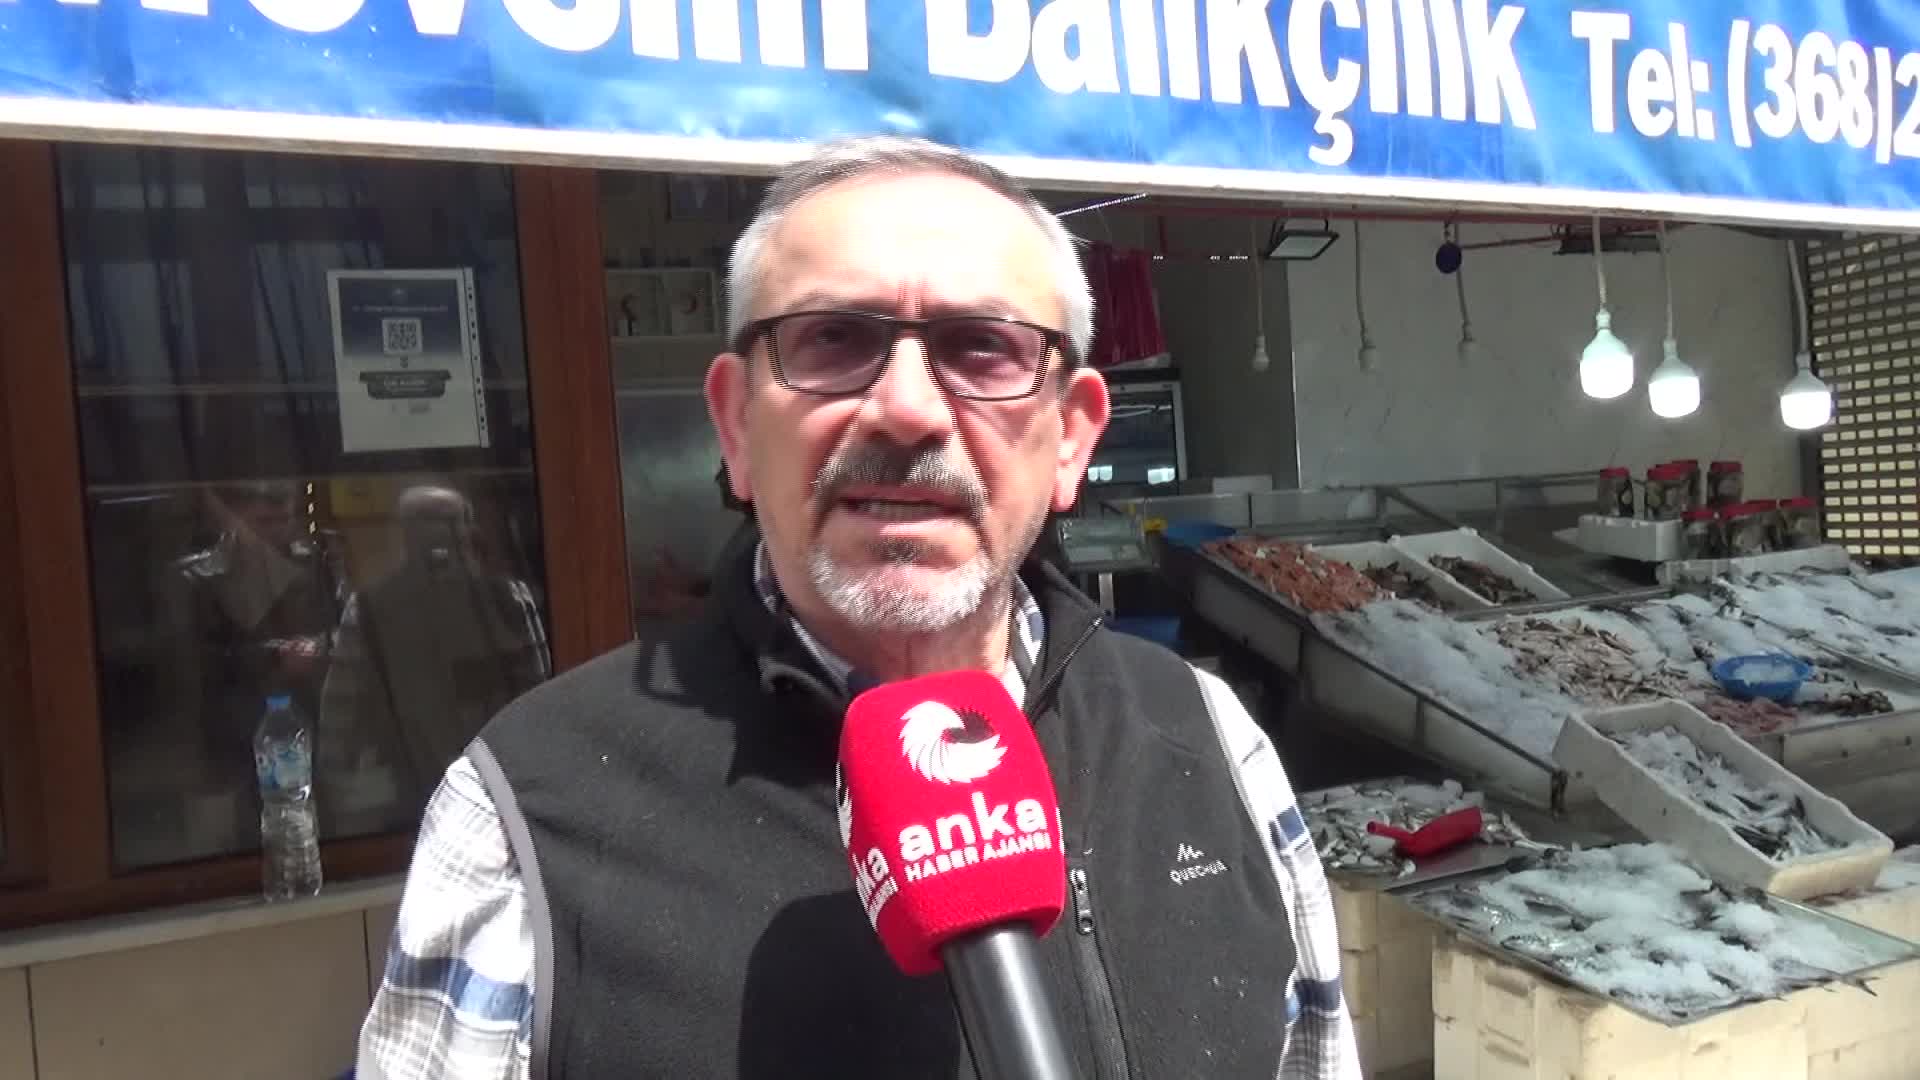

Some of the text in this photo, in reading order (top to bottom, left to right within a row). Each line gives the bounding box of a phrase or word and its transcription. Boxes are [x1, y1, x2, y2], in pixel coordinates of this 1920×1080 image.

[1571, 10, 1716, 141] Tel:
[898, 790, 1048, 863] anka
[904, 832, 1052, 882] HABER AJANSI
[1169, 860, 1229, 886] QUECHUA
